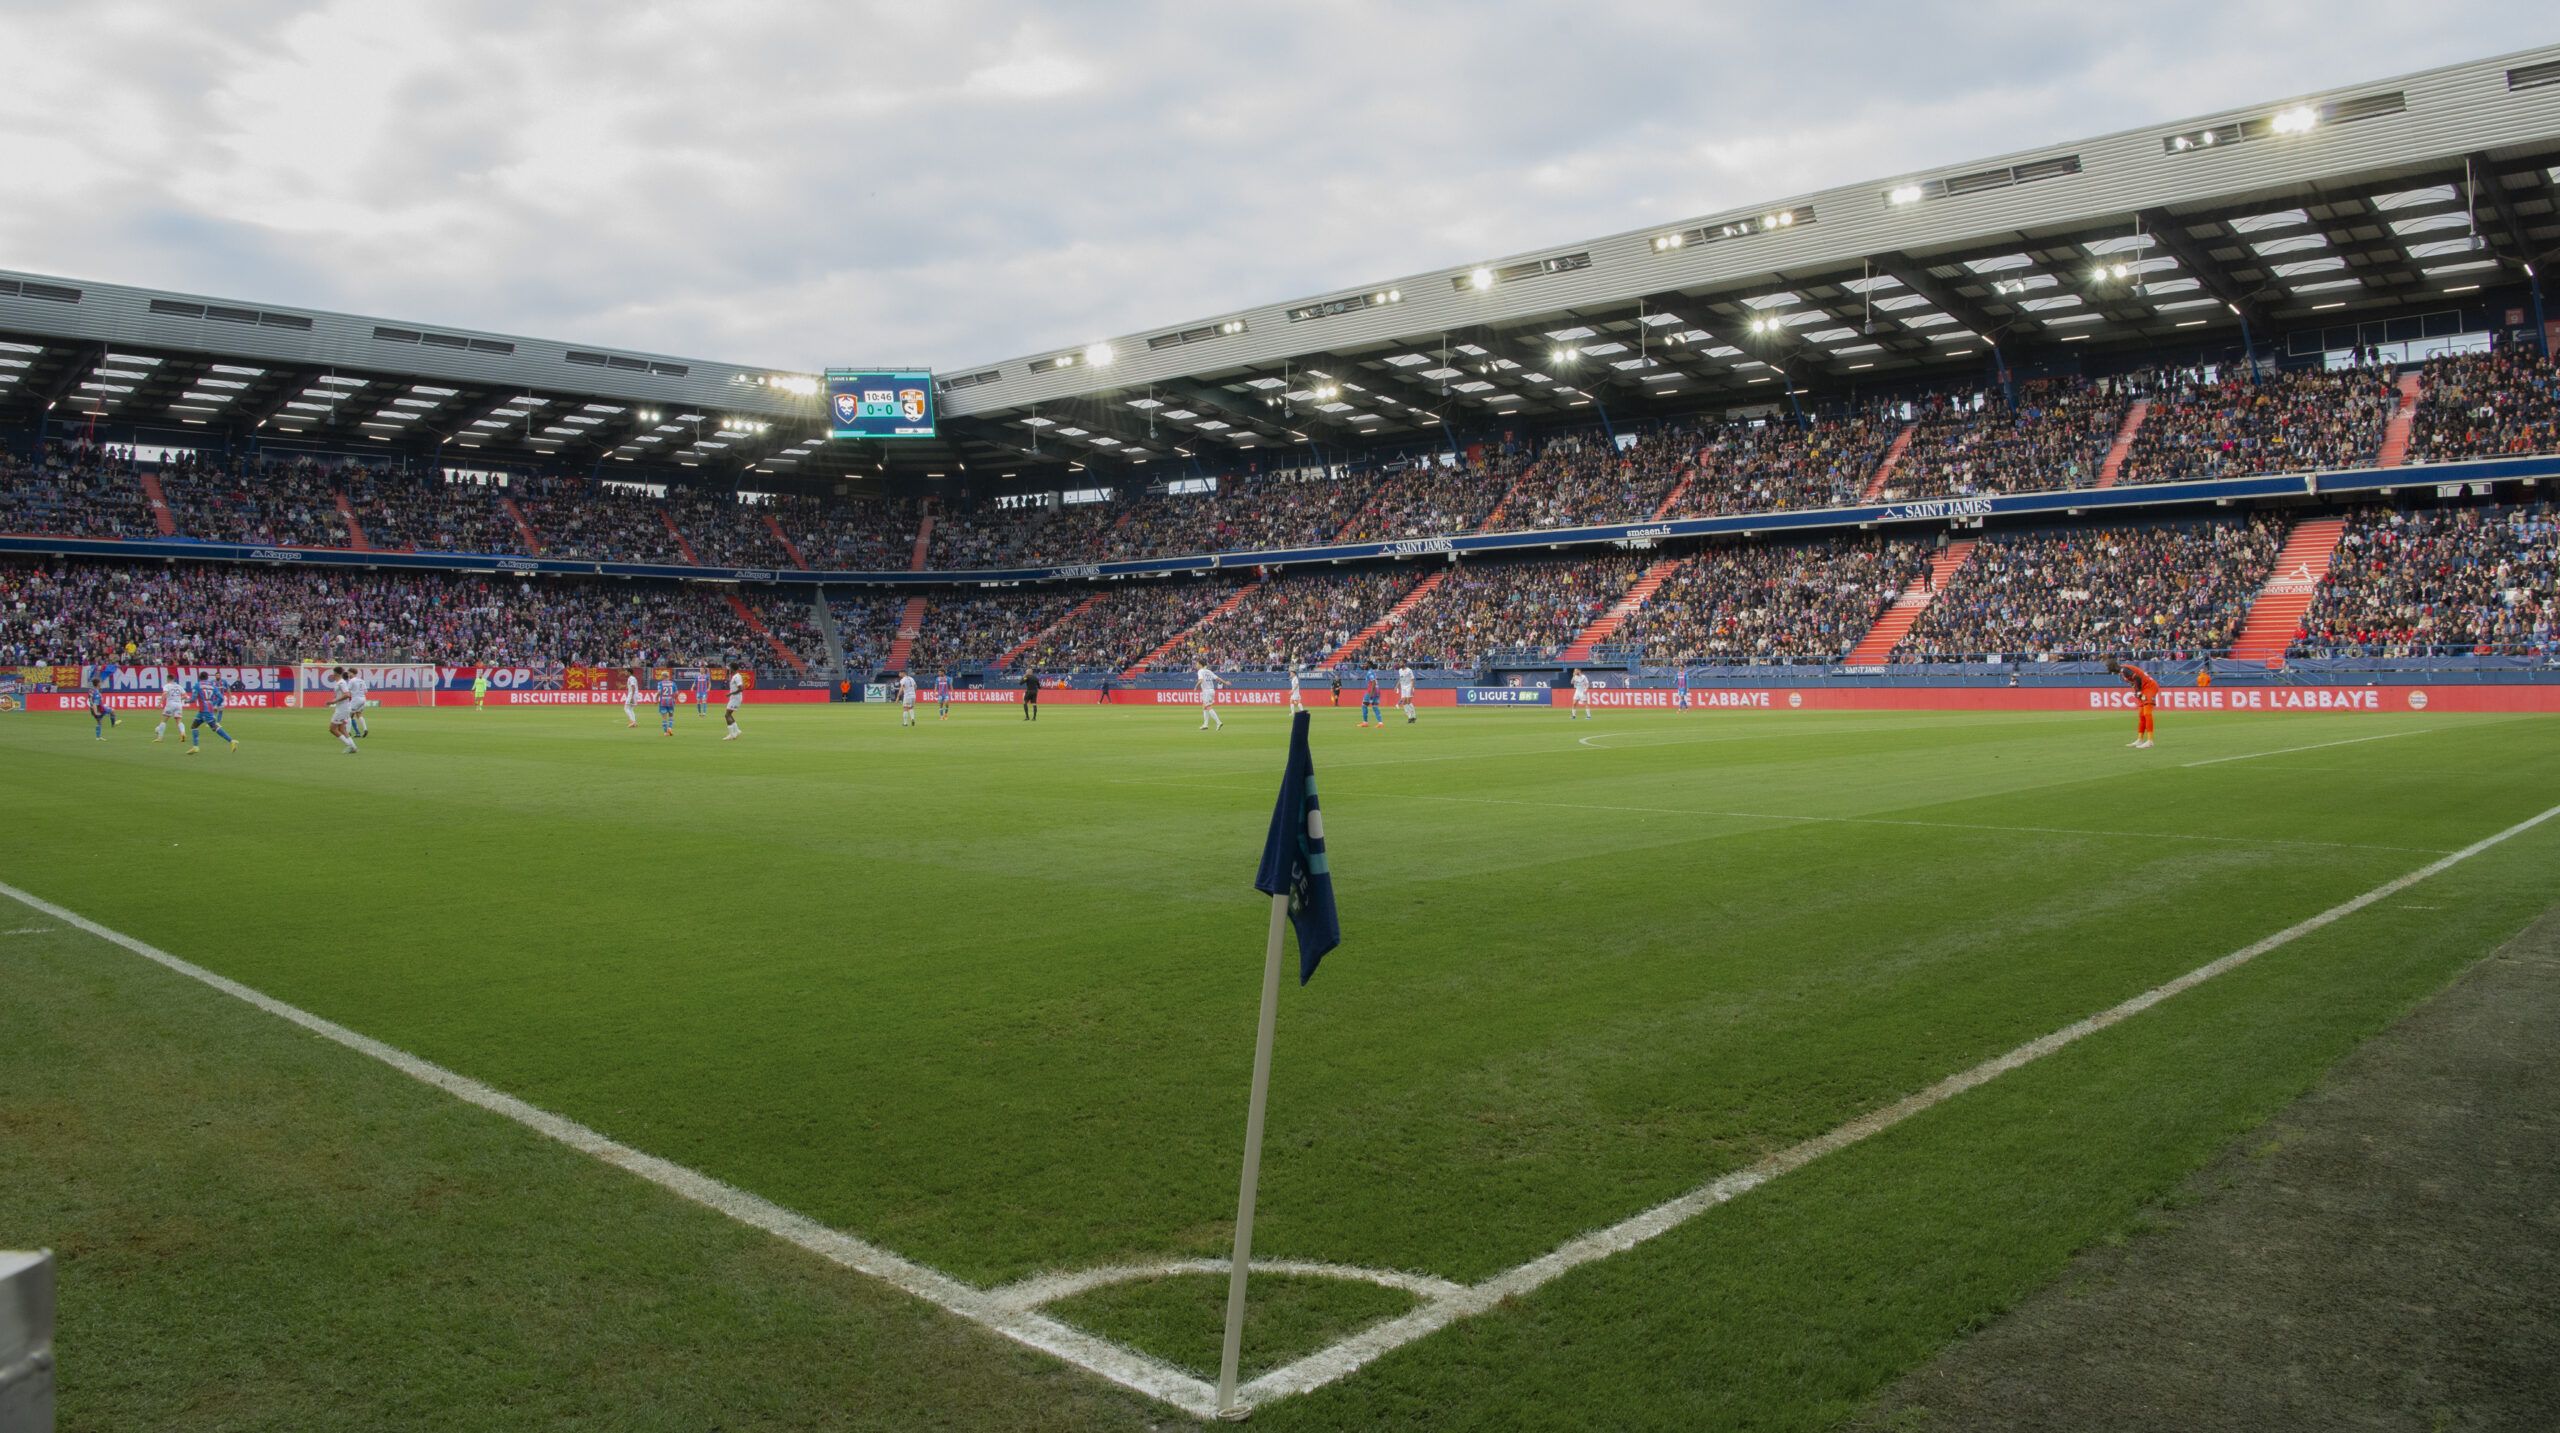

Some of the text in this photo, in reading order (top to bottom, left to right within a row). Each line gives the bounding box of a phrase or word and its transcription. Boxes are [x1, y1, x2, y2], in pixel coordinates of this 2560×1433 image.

[866, 393, 892, 401] 10:46
[867, 404, 874, 415] 0
[886, 404, 893, 415] 0
[1905, 499, 1992, 519] SAINT JAMES
[1626, 524, 1671, 537] smcaen.fr
[1396, 539, 1453, 554] SAINT JAMES
[264, 551, 302, 560] Kappa
[1060, 565, 1100, 578] SAINT JAMES
[203, 689, 213, 699] 17
[662, 686, 673, 696] 21
[967, 691, 979, 702] DE
[980, 691, 1014, 702] L'ABBAYE
[1479, 691, 1540, 701] LIGUE 2 BKT
[510, 692, 590, 704] BISCUITERIE
[591, 692, 608, 703] DE
[1218, 692, 1232, 703] DE
[1234, 692, 1281, 704] L'ABBAYE
[1697, 692, 1770, 707] L'ABBAYE
[2089, 690, 2379, 708] BISCITERIE DE L'ABBAYE
